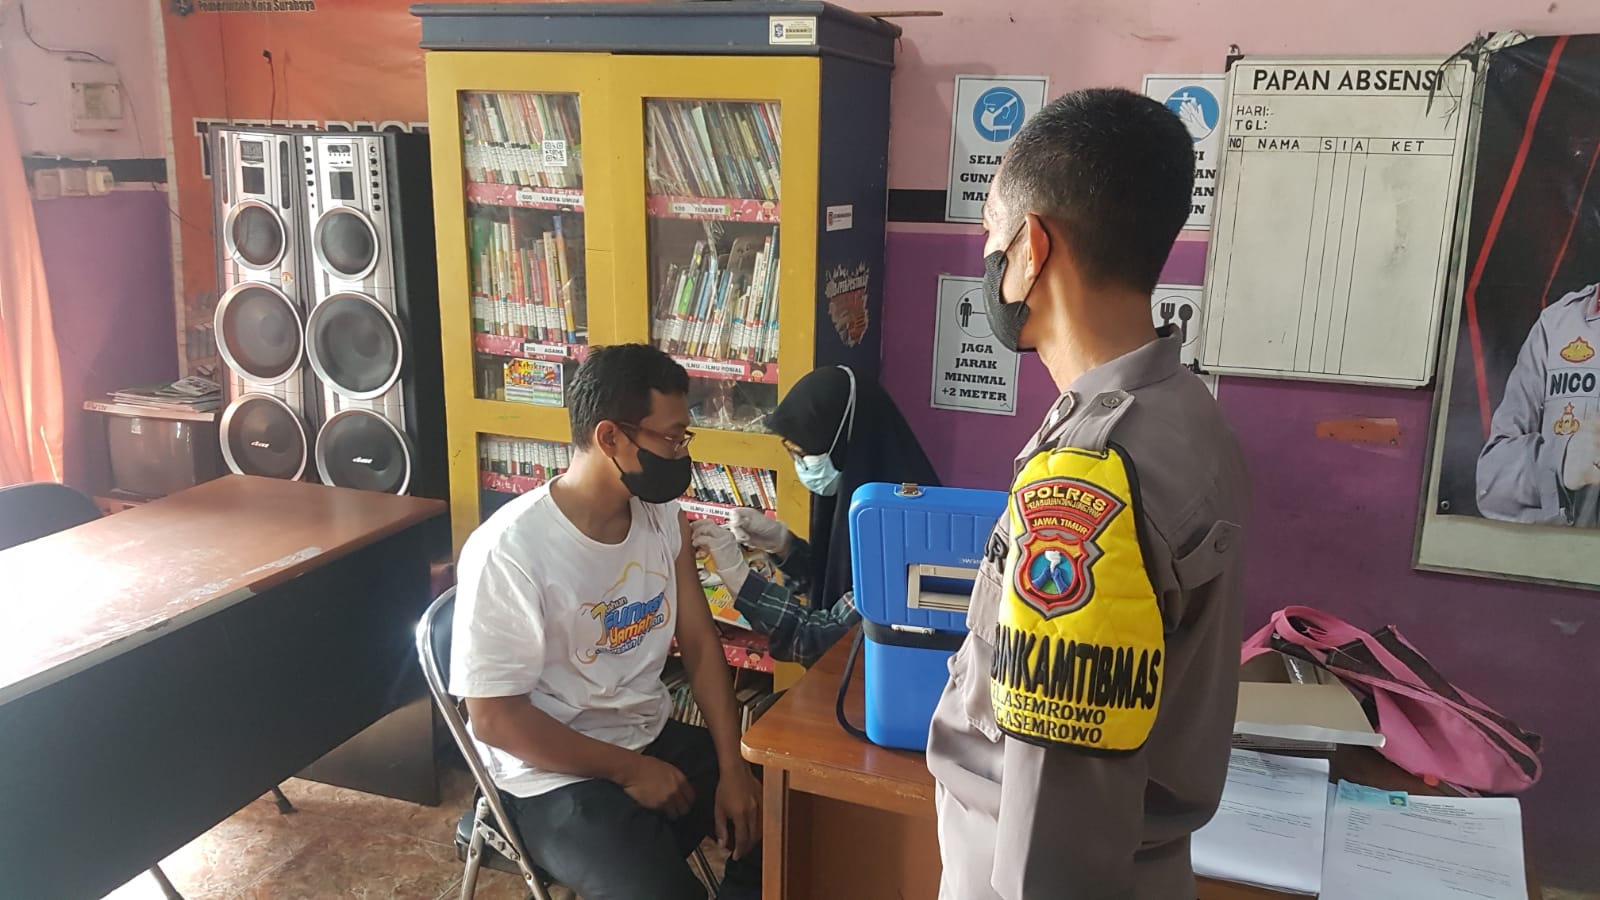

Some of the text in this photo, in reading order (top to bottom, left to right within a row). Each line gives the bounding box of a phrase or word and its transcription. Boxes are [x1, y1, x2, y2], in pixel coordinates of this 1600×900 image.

[273, 1, 314, 11] Surabaya
[1253, 70, 1444, 92] PAPAN ABSENSI
[1229, 138, 1242, 149] NO
[1257, 138, 1301, 150] NAMA
[1325, 140, 1332, 151] S
[1354, 140, 1364, 151] A
[1392, 140, 1425, 152] KET
[969, 154, 1005, 165] SELA
[961, 343, 993, 354] JAGA
[955, 358, 997, 369] JARAK
[945, 372, 1006, 386] MINIMAL
[1550, 372, 1596, 396] NICO
[942, 388, 1007, 401] +2 METER
[1023, 485, 1107, 512] POLRES
[1032, 517, 1088, 535] JAWA TIMUR
[1004, 690, 1106, 725] ASEMROWO
[1004, 709, 1102, 744] ASEMROWO
